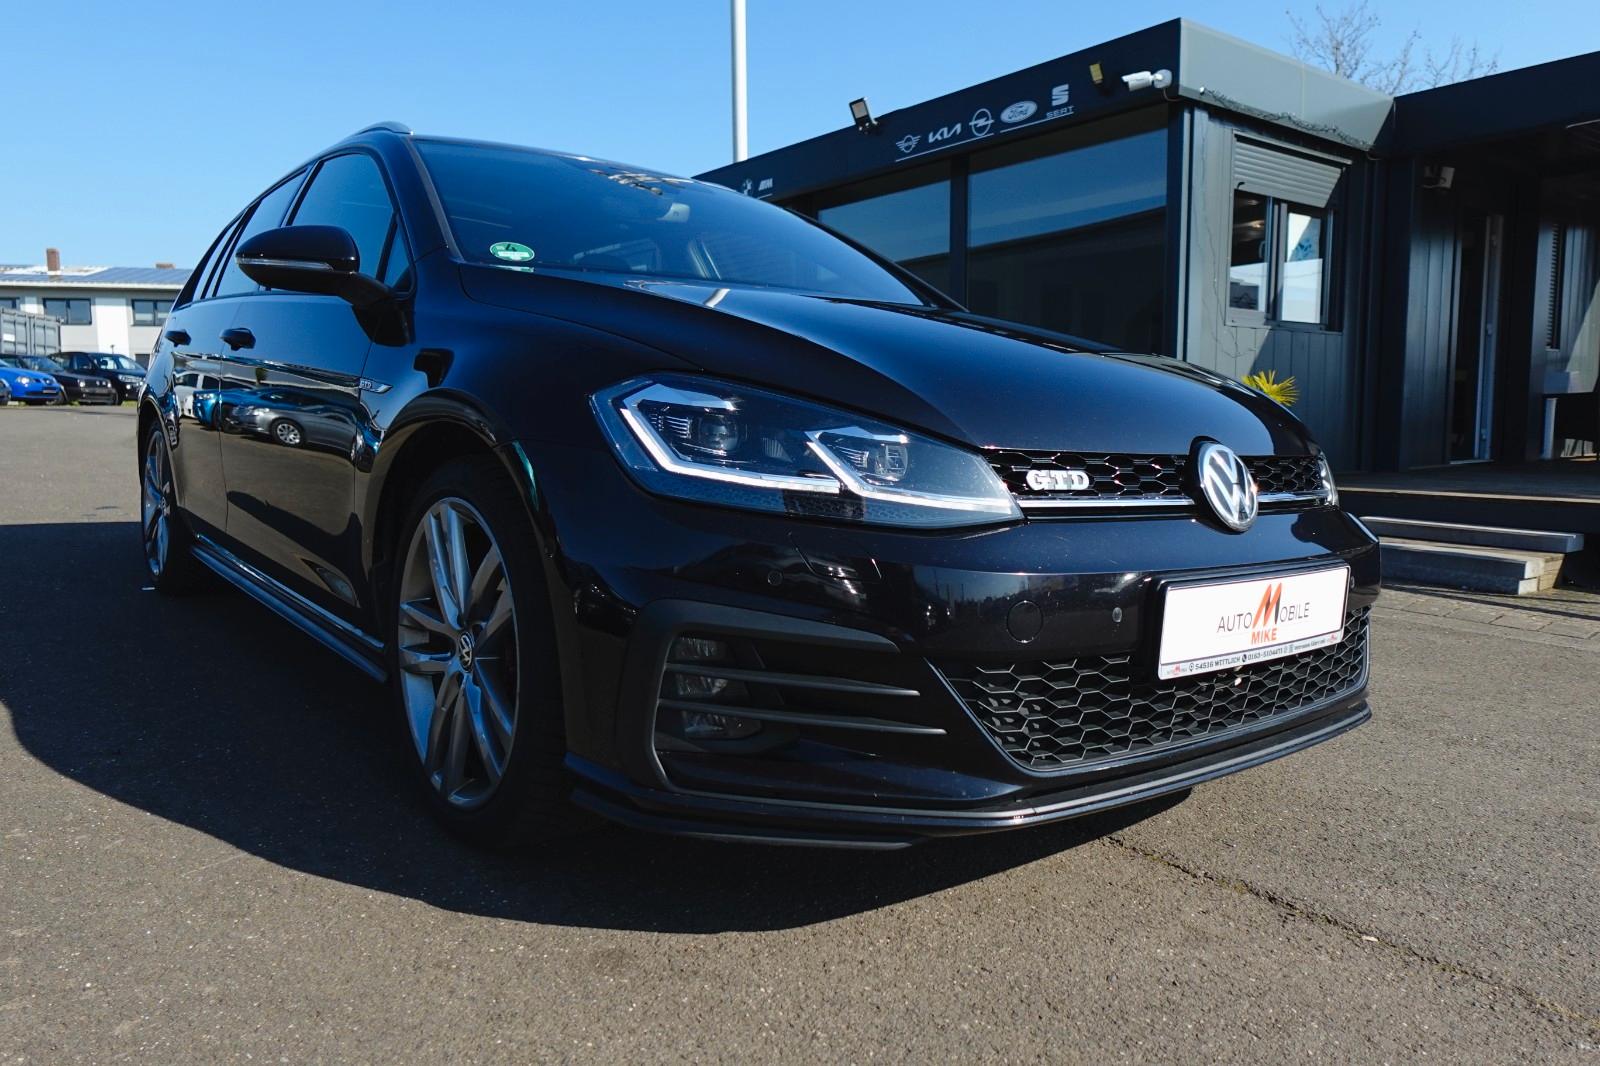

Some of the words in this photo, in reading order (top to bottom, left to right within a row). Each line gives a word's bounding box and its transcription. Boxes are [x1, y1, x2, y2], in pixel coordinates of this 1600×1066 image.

[1046, 105, 1075, 119] SEAT
[1025, 469, 1089, 491] GTD
[1251, 627, 1278, 645] MIKE
